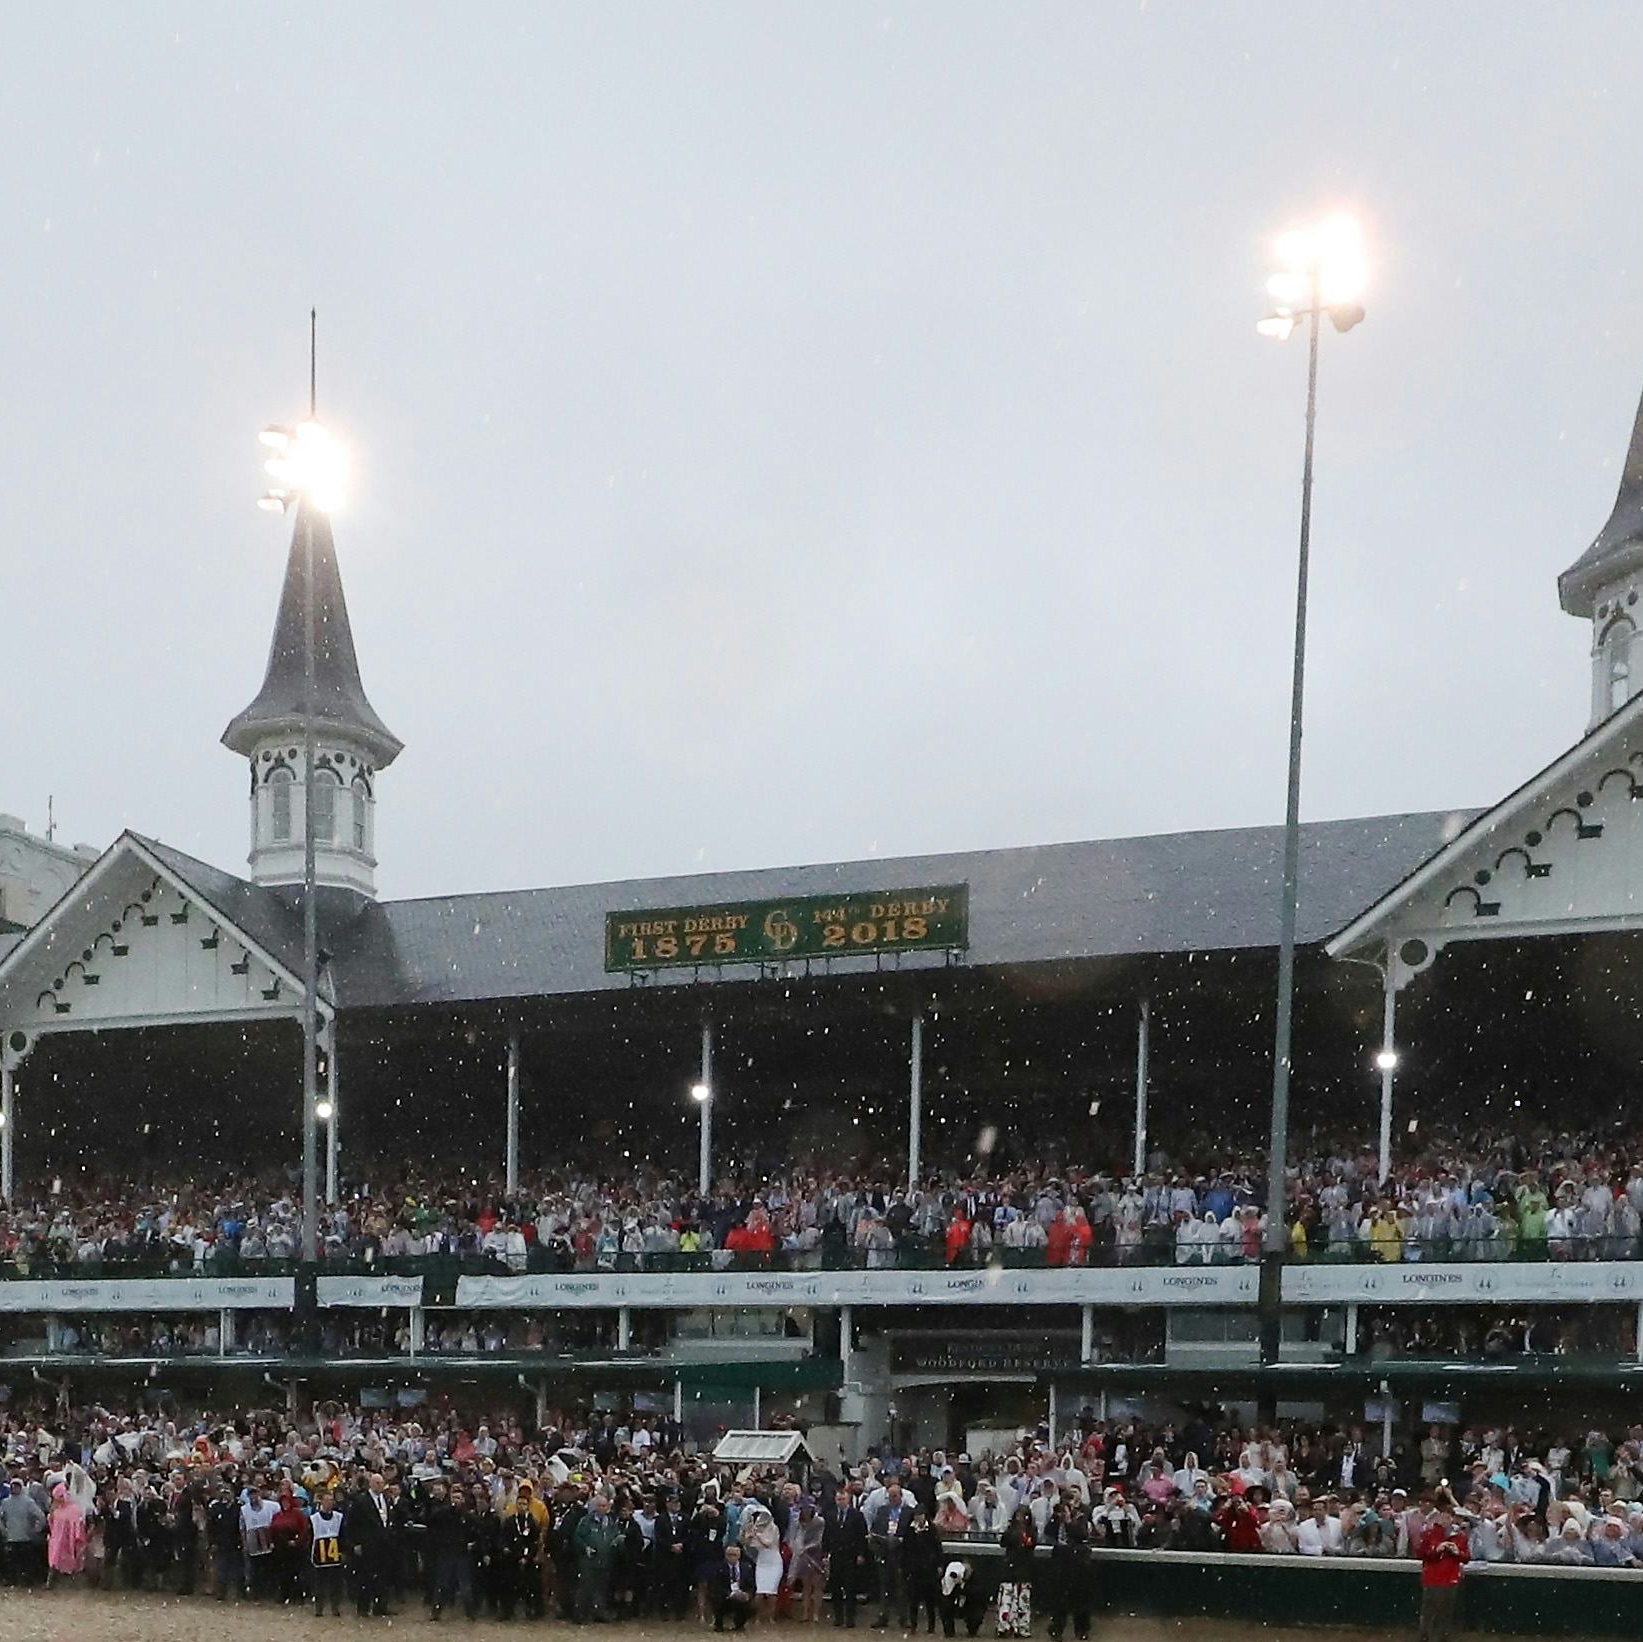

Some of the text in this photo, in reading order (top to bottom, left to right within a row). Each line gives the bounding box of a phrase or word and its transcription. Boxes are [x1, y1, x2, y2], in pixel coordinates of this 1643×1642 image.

[869, 899, 950, 918] DERBY
[618, 915, 749, 938] FIRST DERBY
[822, 917, 928, 948] 2018
[632, 933, 737, 960] 1875
[746, 1281, 795, 1291] LONGINES
[1163, 1276, 1218, 1286] LONGINES
[1403, 1274, 1463, 1284] LONGINES
[319, 1537, 342, 1563] 14
